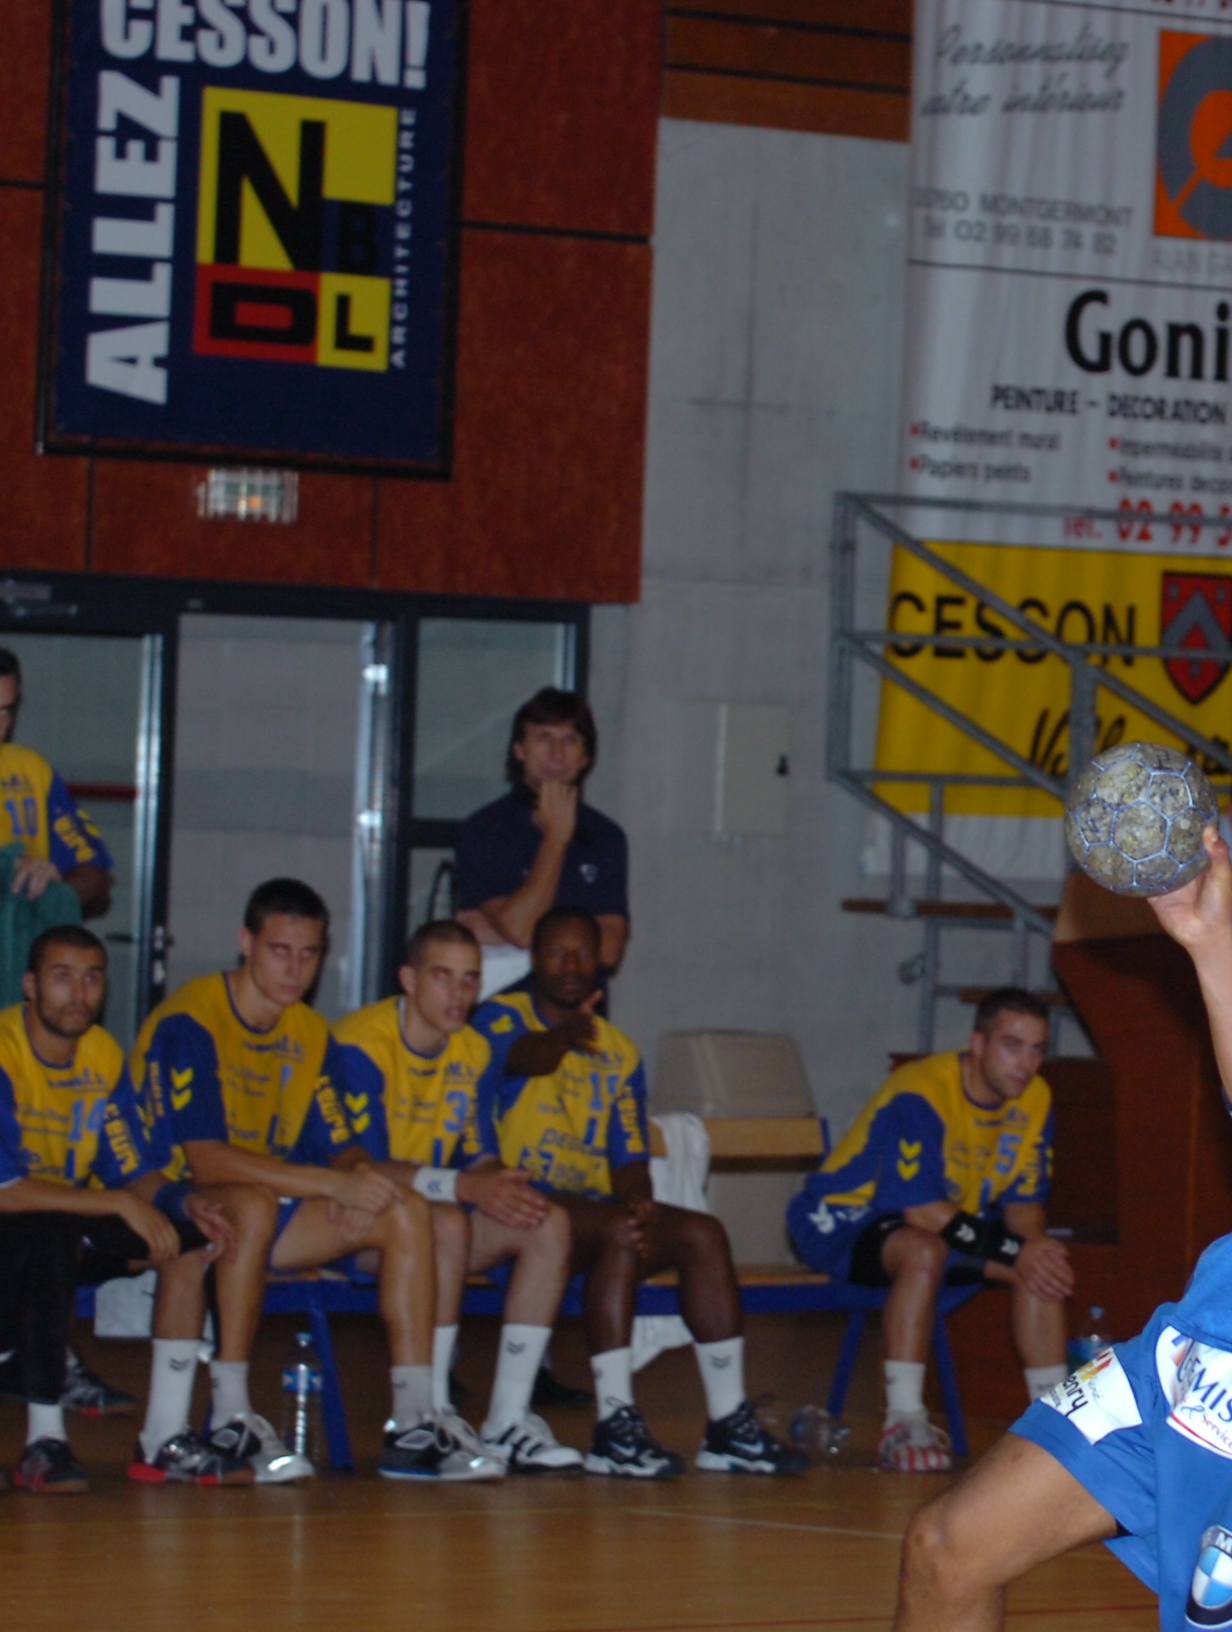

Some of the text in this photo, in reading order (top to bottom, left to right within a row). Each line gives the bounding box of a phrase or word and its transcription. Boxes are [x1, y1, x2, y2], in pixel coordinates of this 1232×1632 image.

[100, 0, 431, 90] CESSON!
[84, 68, 181, 407] ALLEZ
[391, 107, 416, 370] ARCHITECTURE
[1064, 289, 1232, 383] Goni
[888, 590, 1138, 665] CESSON
[444, 1089, 471, 1134] 3
[994, 1132, 1022, 1176] 5
